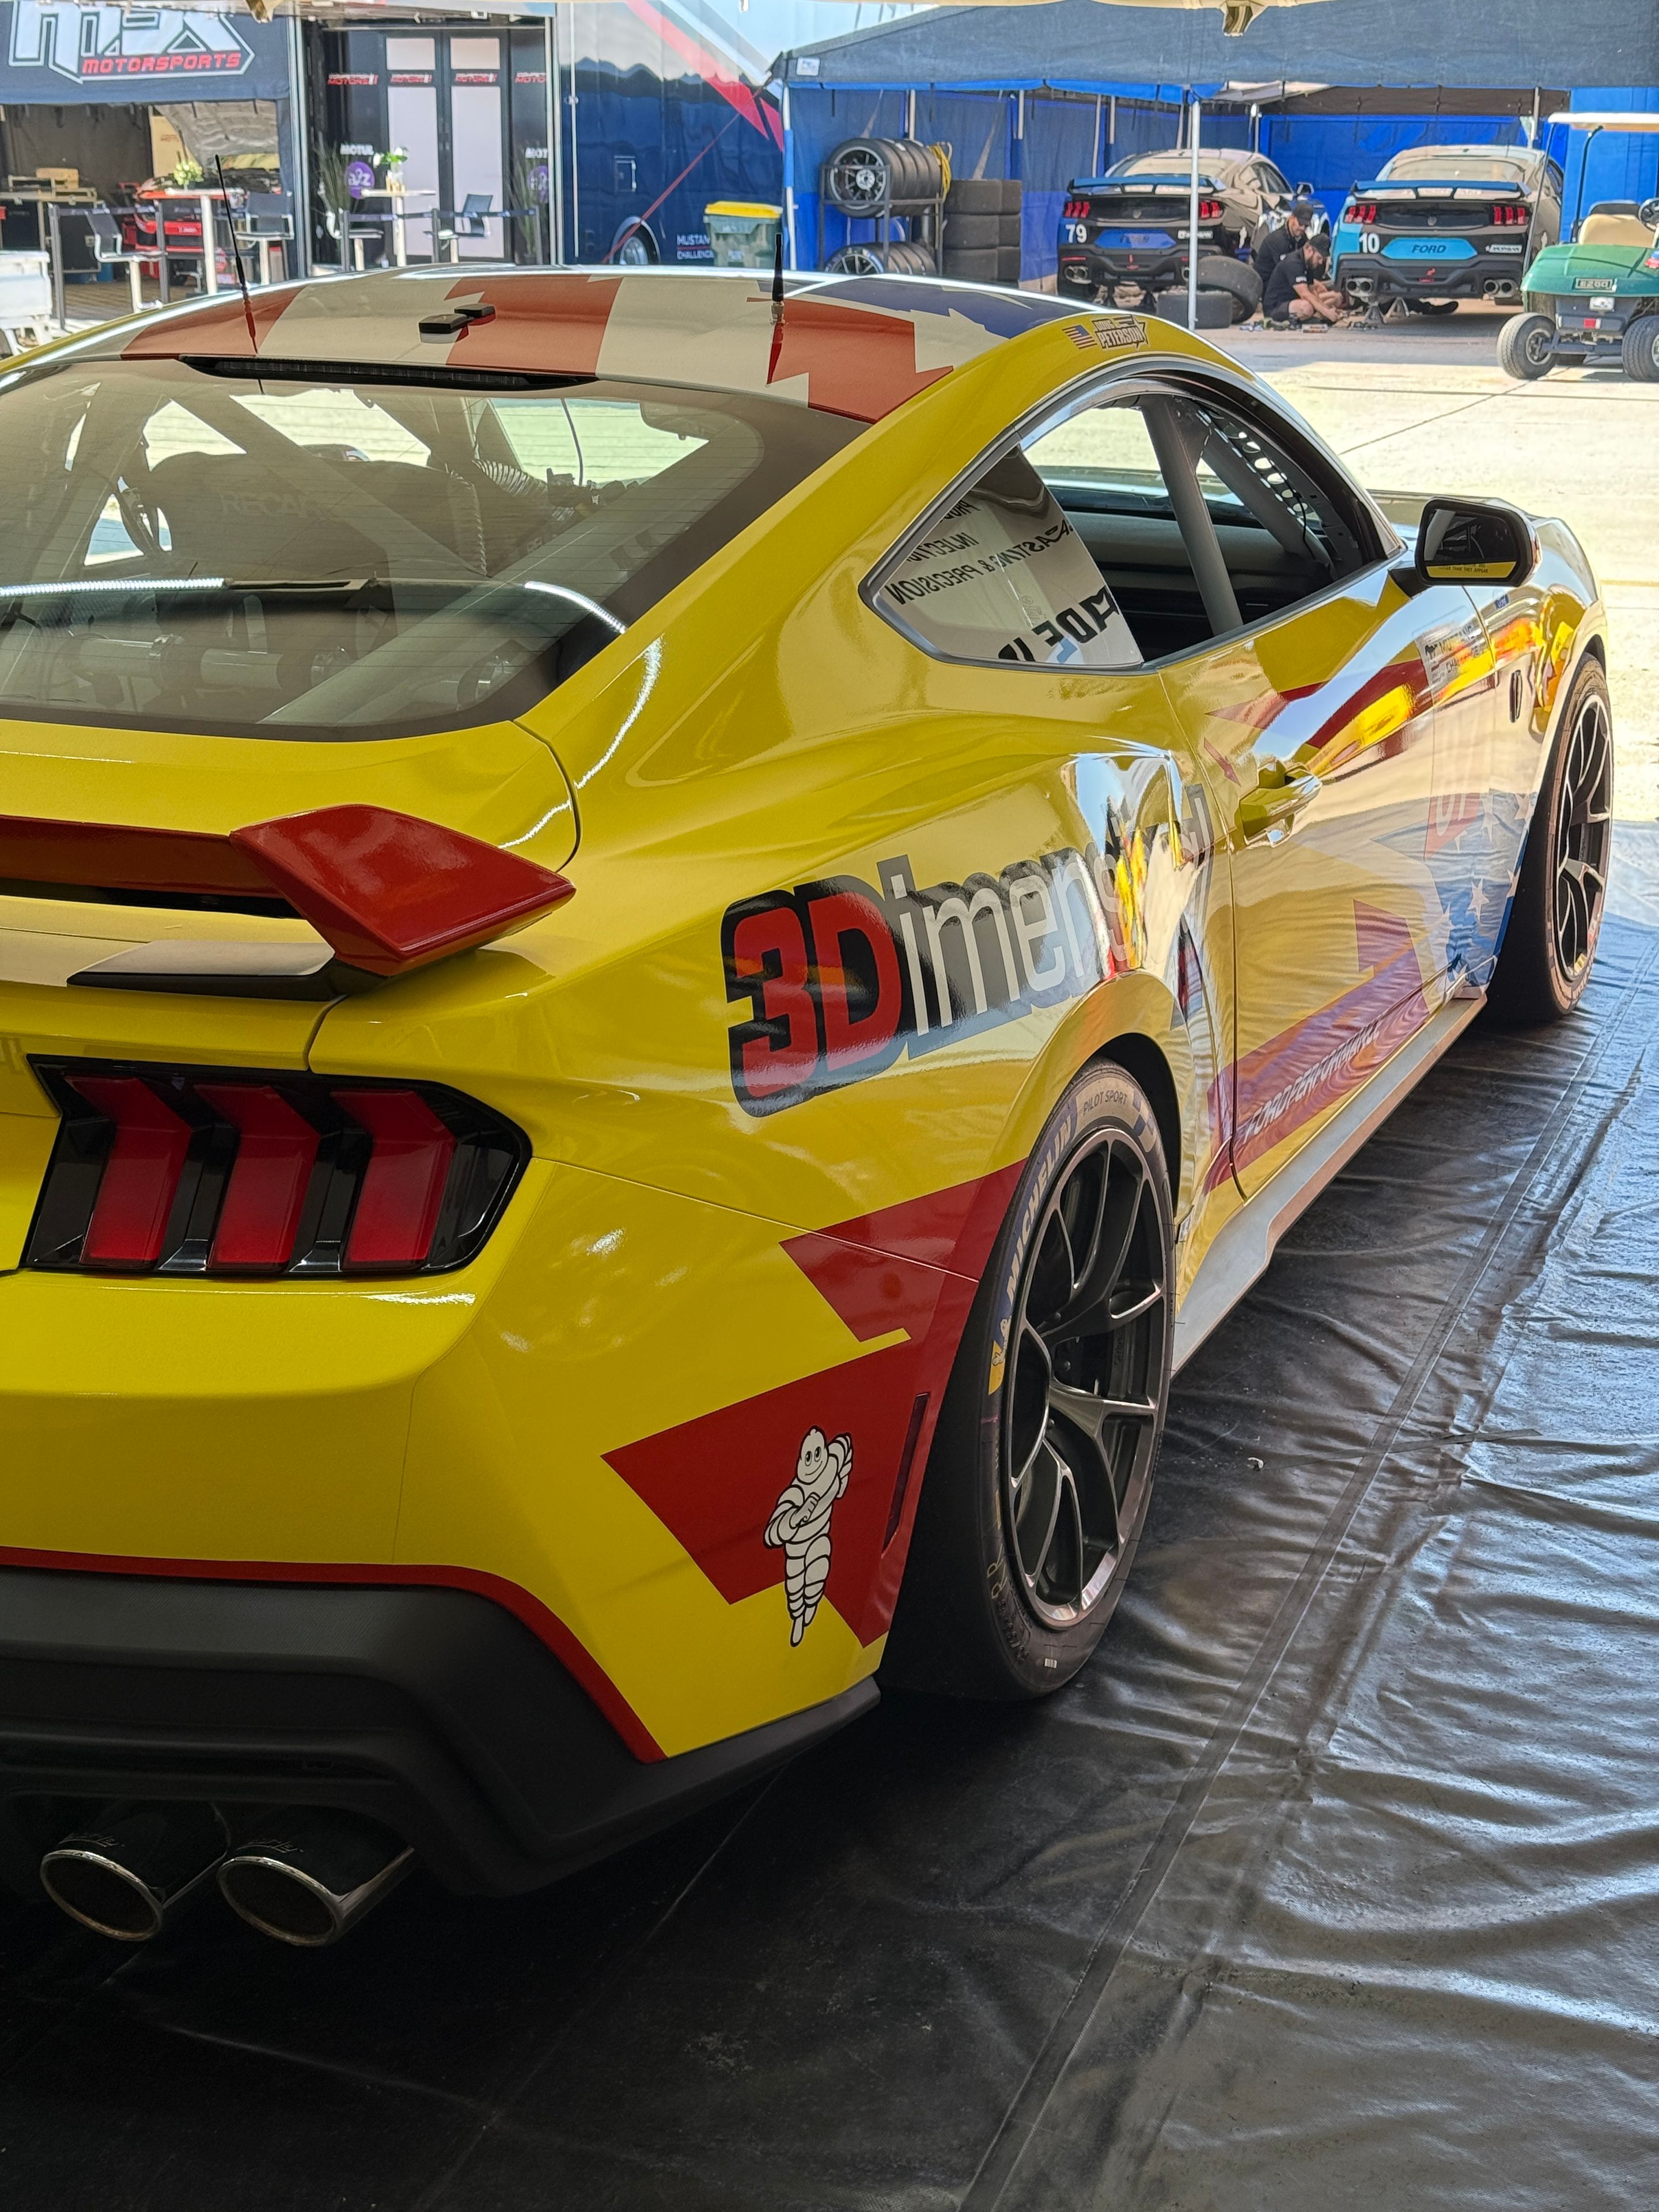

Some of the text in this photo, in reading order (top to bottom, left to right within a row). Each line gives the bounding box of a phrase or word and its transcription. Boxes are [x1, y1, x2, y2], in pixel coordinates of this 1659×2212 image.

[82, 53, 241, 74] MOTORSPORTS
[340, 144, 374, 156] MOTUL
[1066, 224, 1088, 244] 79
[1359, 233, 1380, 253] 10
[1411, 245, 1447, 253] FORD
[1097, 327, 1145, 348] PETERSON
[1082, 1090, 1128, 1116] PILOT SPORT
[1006, 1115, 1072, 1306] MICHELIN
